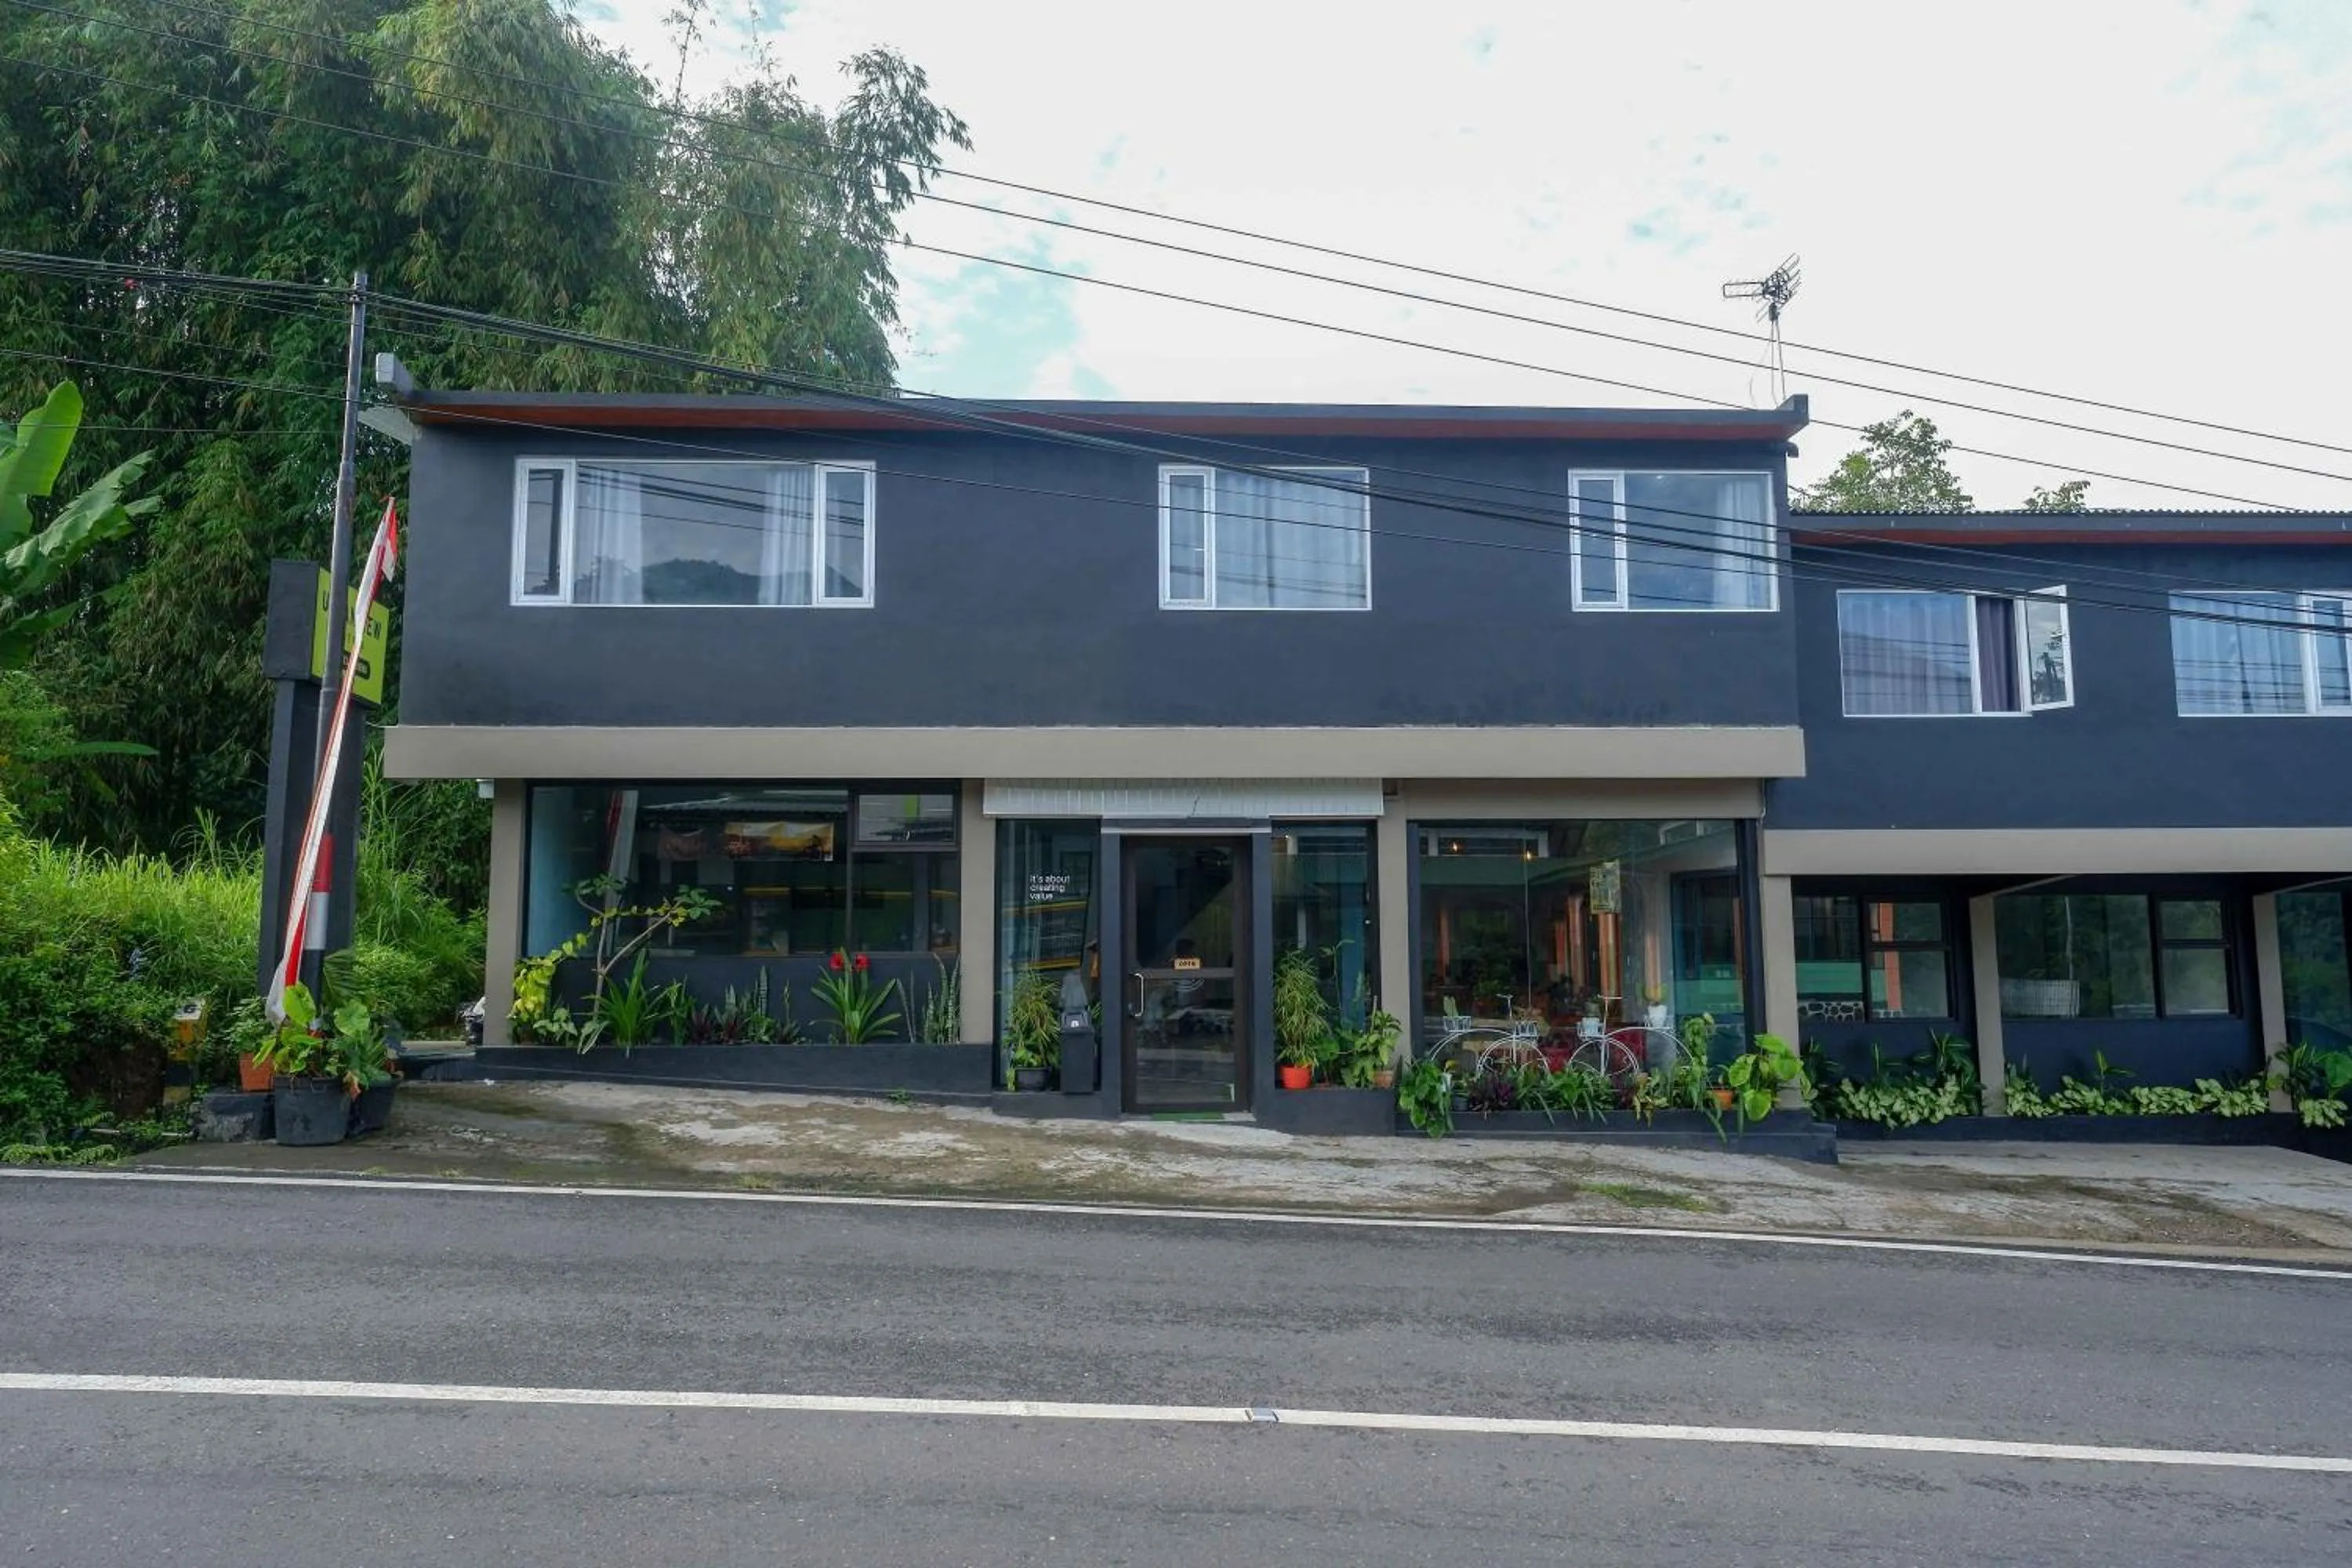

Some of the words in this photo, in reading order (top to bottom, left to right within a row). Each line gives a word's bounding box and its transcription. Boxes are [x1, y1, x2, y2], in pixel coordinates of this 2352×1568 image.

[1045, 874, 1070, 884] about
[1029, 884, 1065, 893] creating
[1029, 892, 1054, 901] value
